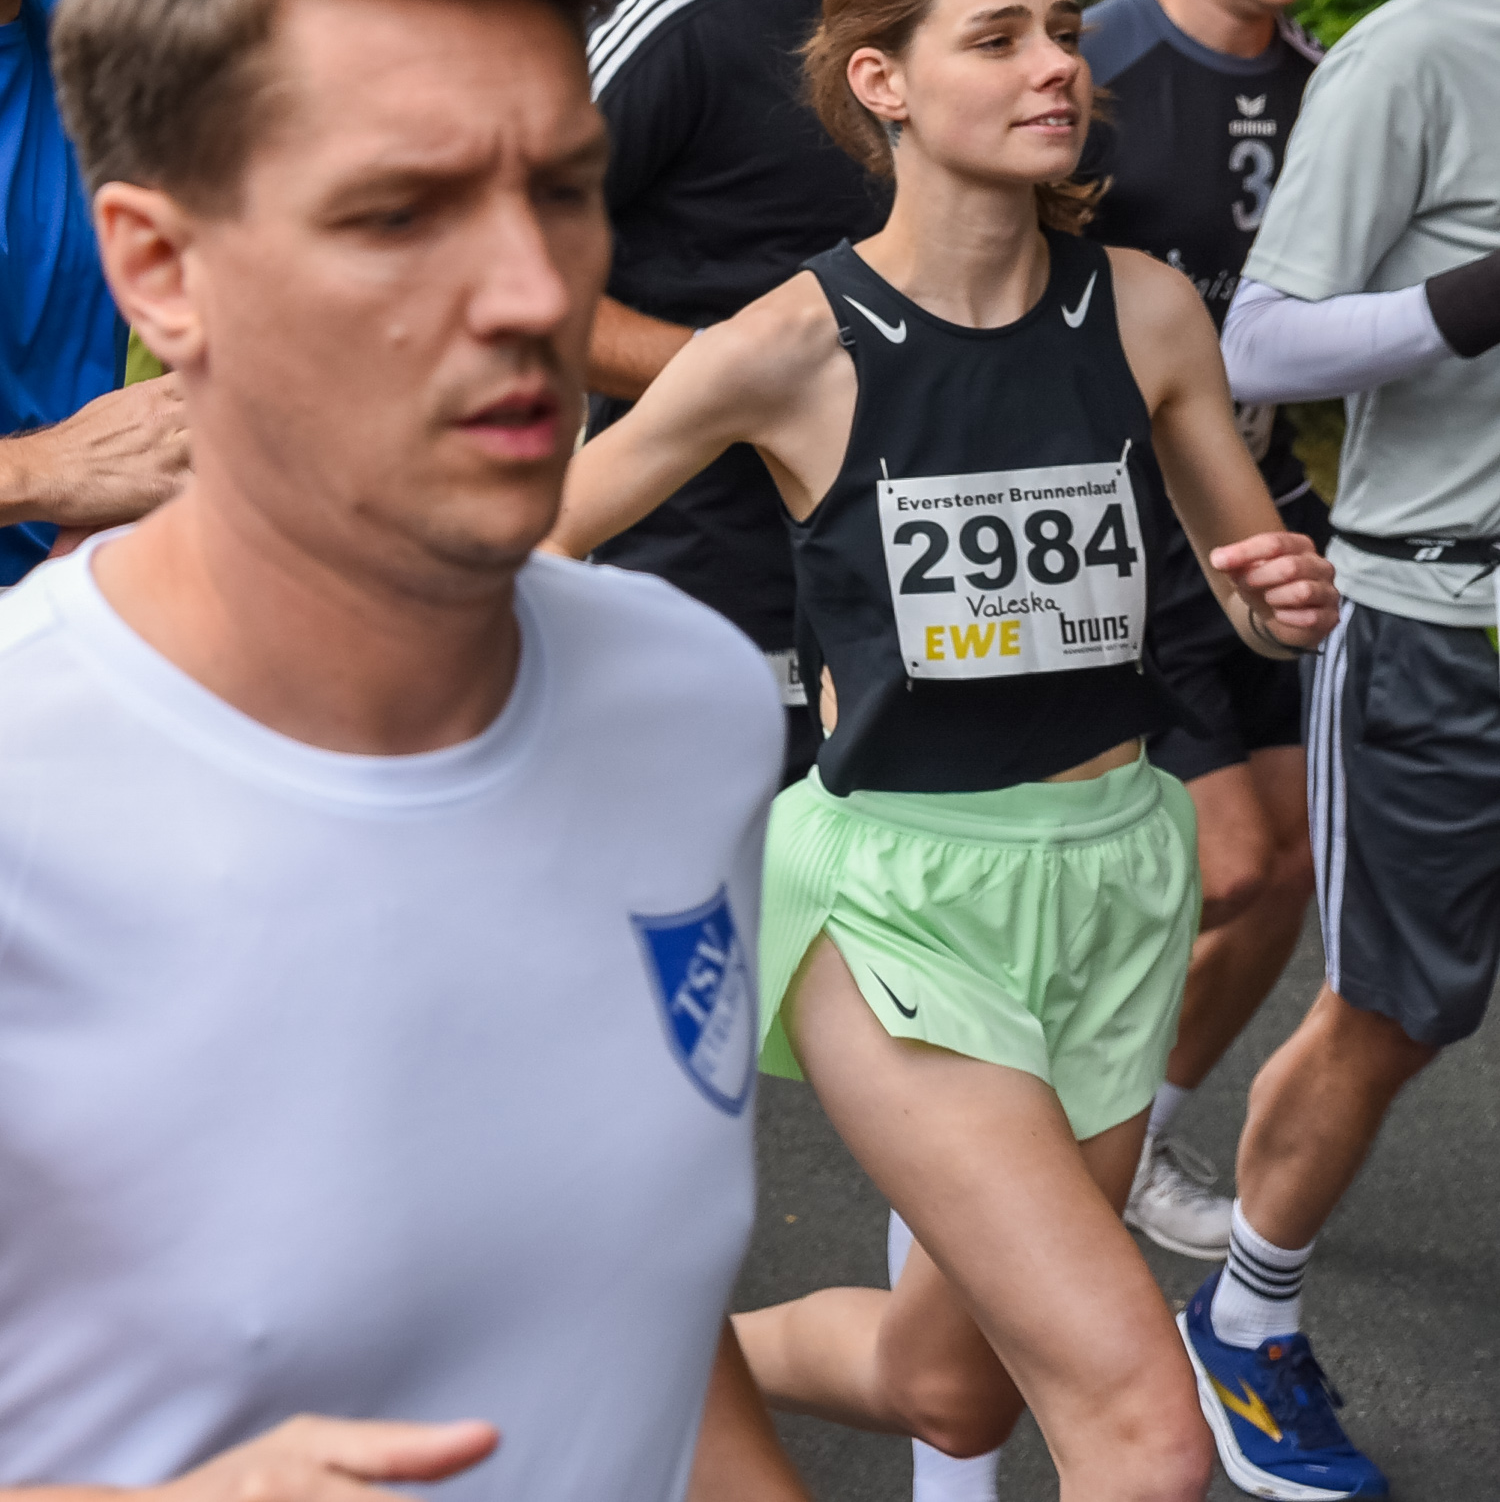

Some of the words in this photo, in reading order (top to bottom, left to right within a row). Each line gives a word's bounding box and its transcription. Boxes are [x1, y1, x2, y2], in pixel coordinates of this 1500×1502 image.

[1228, 137, 1275, 233] 3
[897, 491, 1004, 511] Everstener
[1009, 479, 1118, 503] Brunnenlauf
[893, 502, 1138, 595] 2984
[966, 591, 1061, 617] Valeska
[925, 619, 1021, 661] EWE
[1059, 611, 1130, 645] bruns
